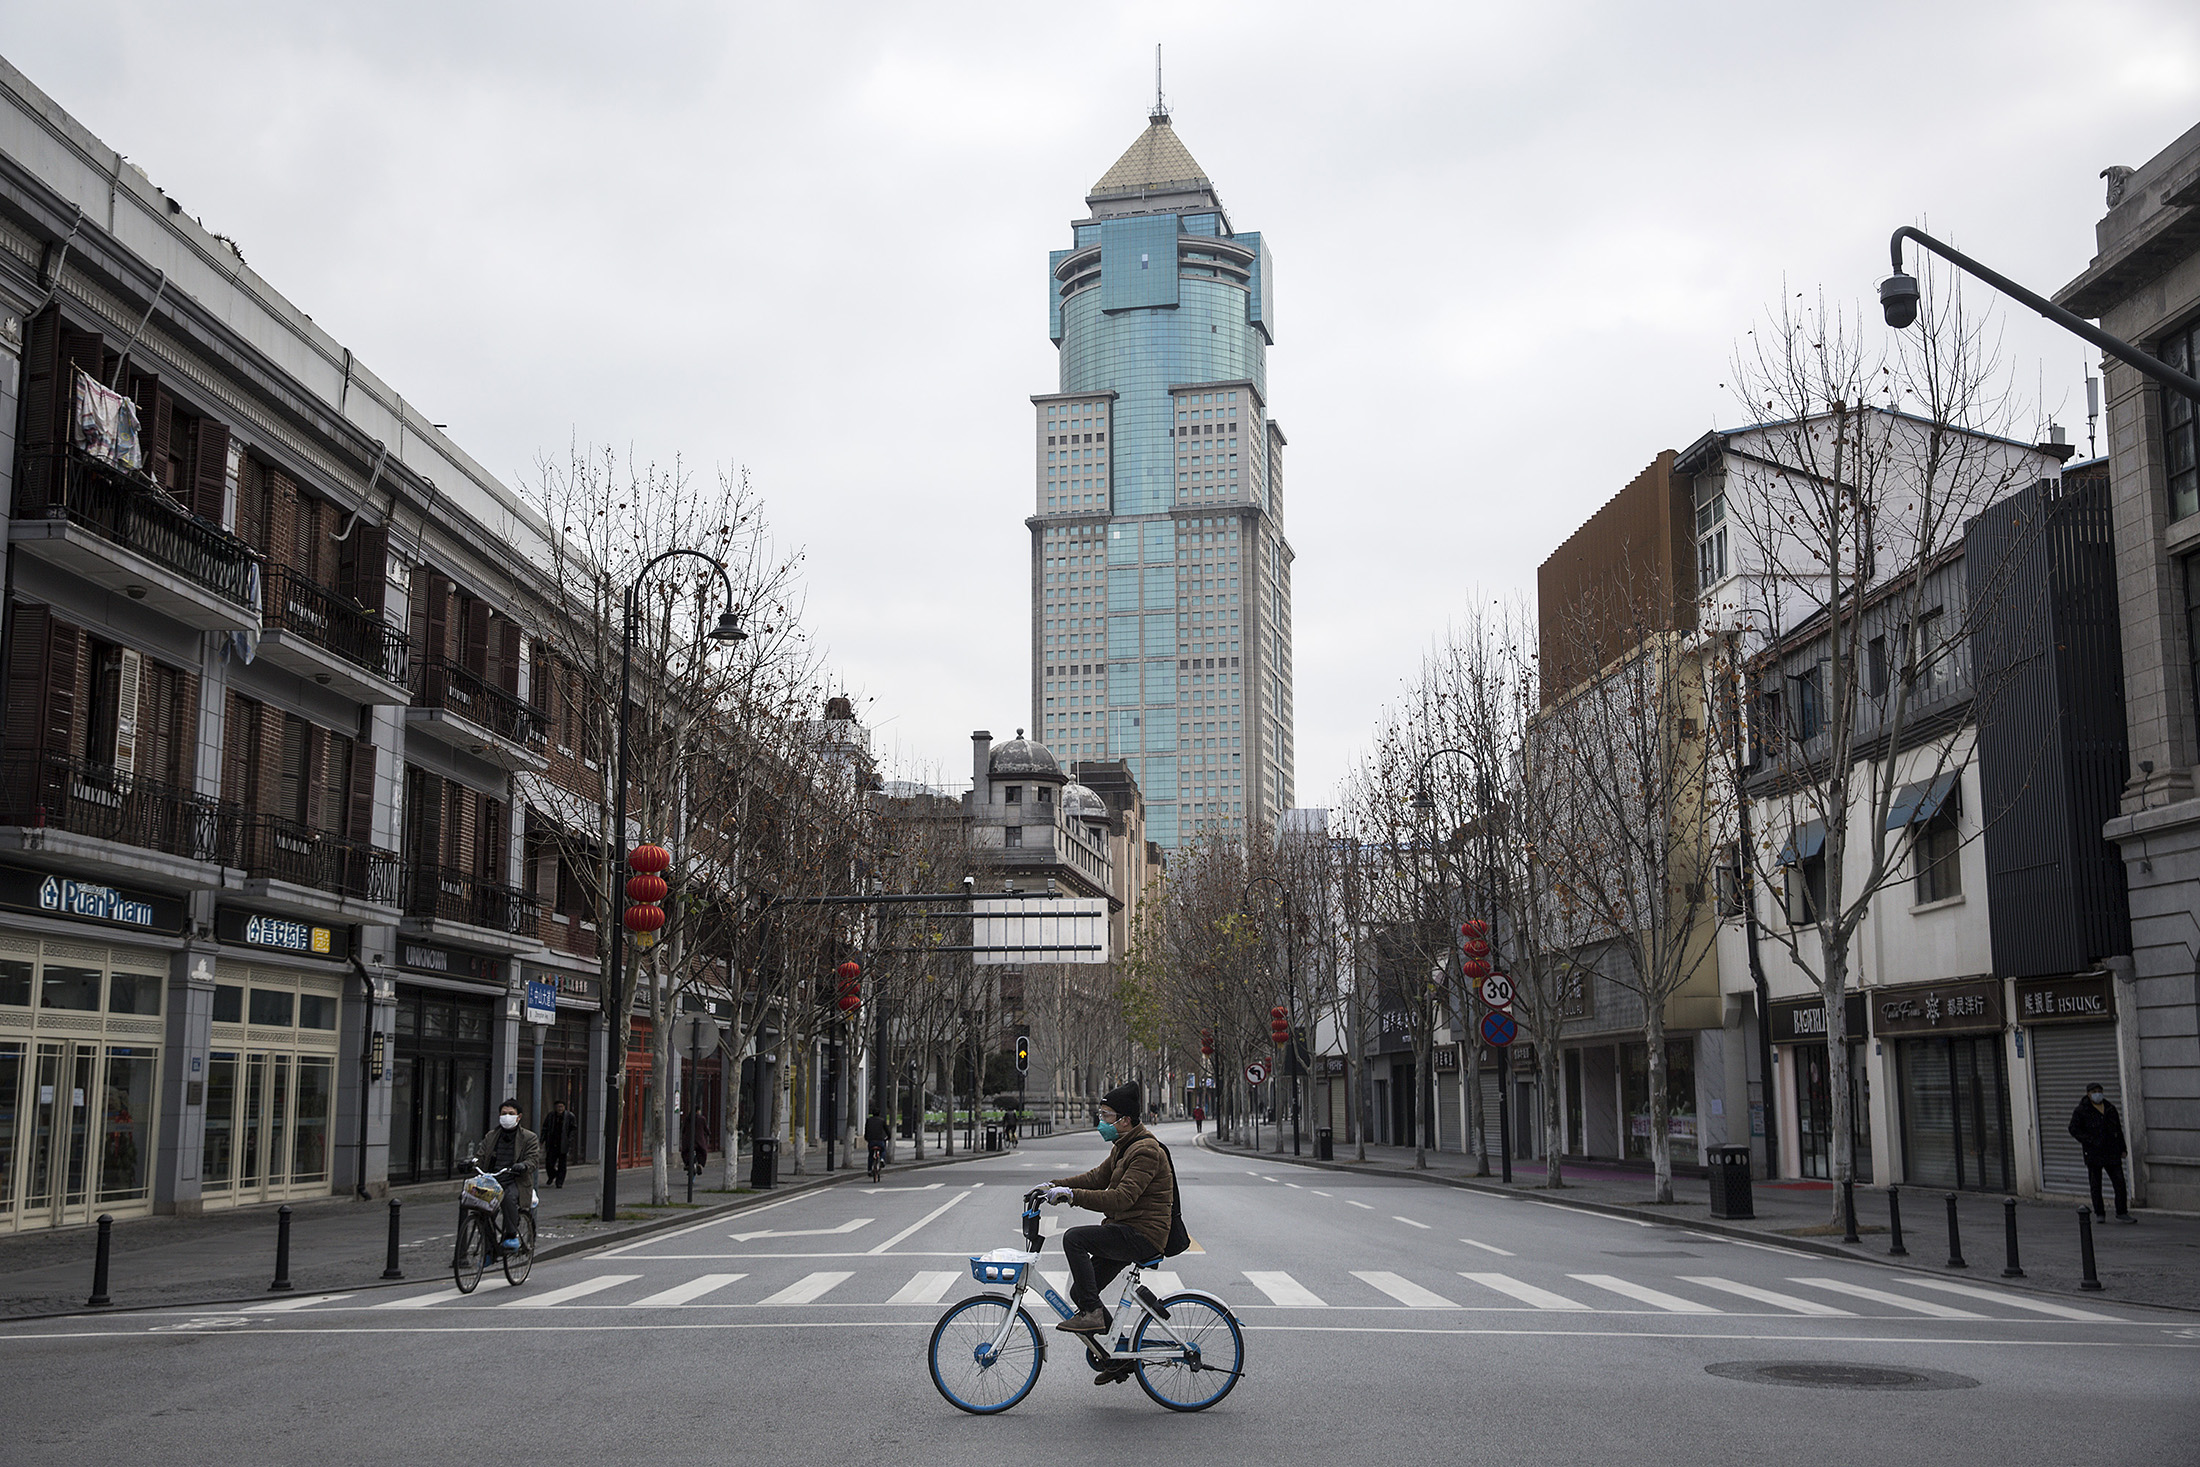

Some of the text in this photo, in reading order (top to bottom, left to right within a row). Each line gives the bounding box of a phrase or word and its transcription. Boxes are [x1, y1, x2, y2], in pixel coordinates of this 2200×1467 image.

[60, 880, 153, 926] PuanPharm
[406, 946, 448, 971] UNKNOWN
[1487, 982, 1509, 999] 30
[1947, 996, 1984, 1017] 都灵洋行
[2058, 995, 2101, 1013] HSIUNG
